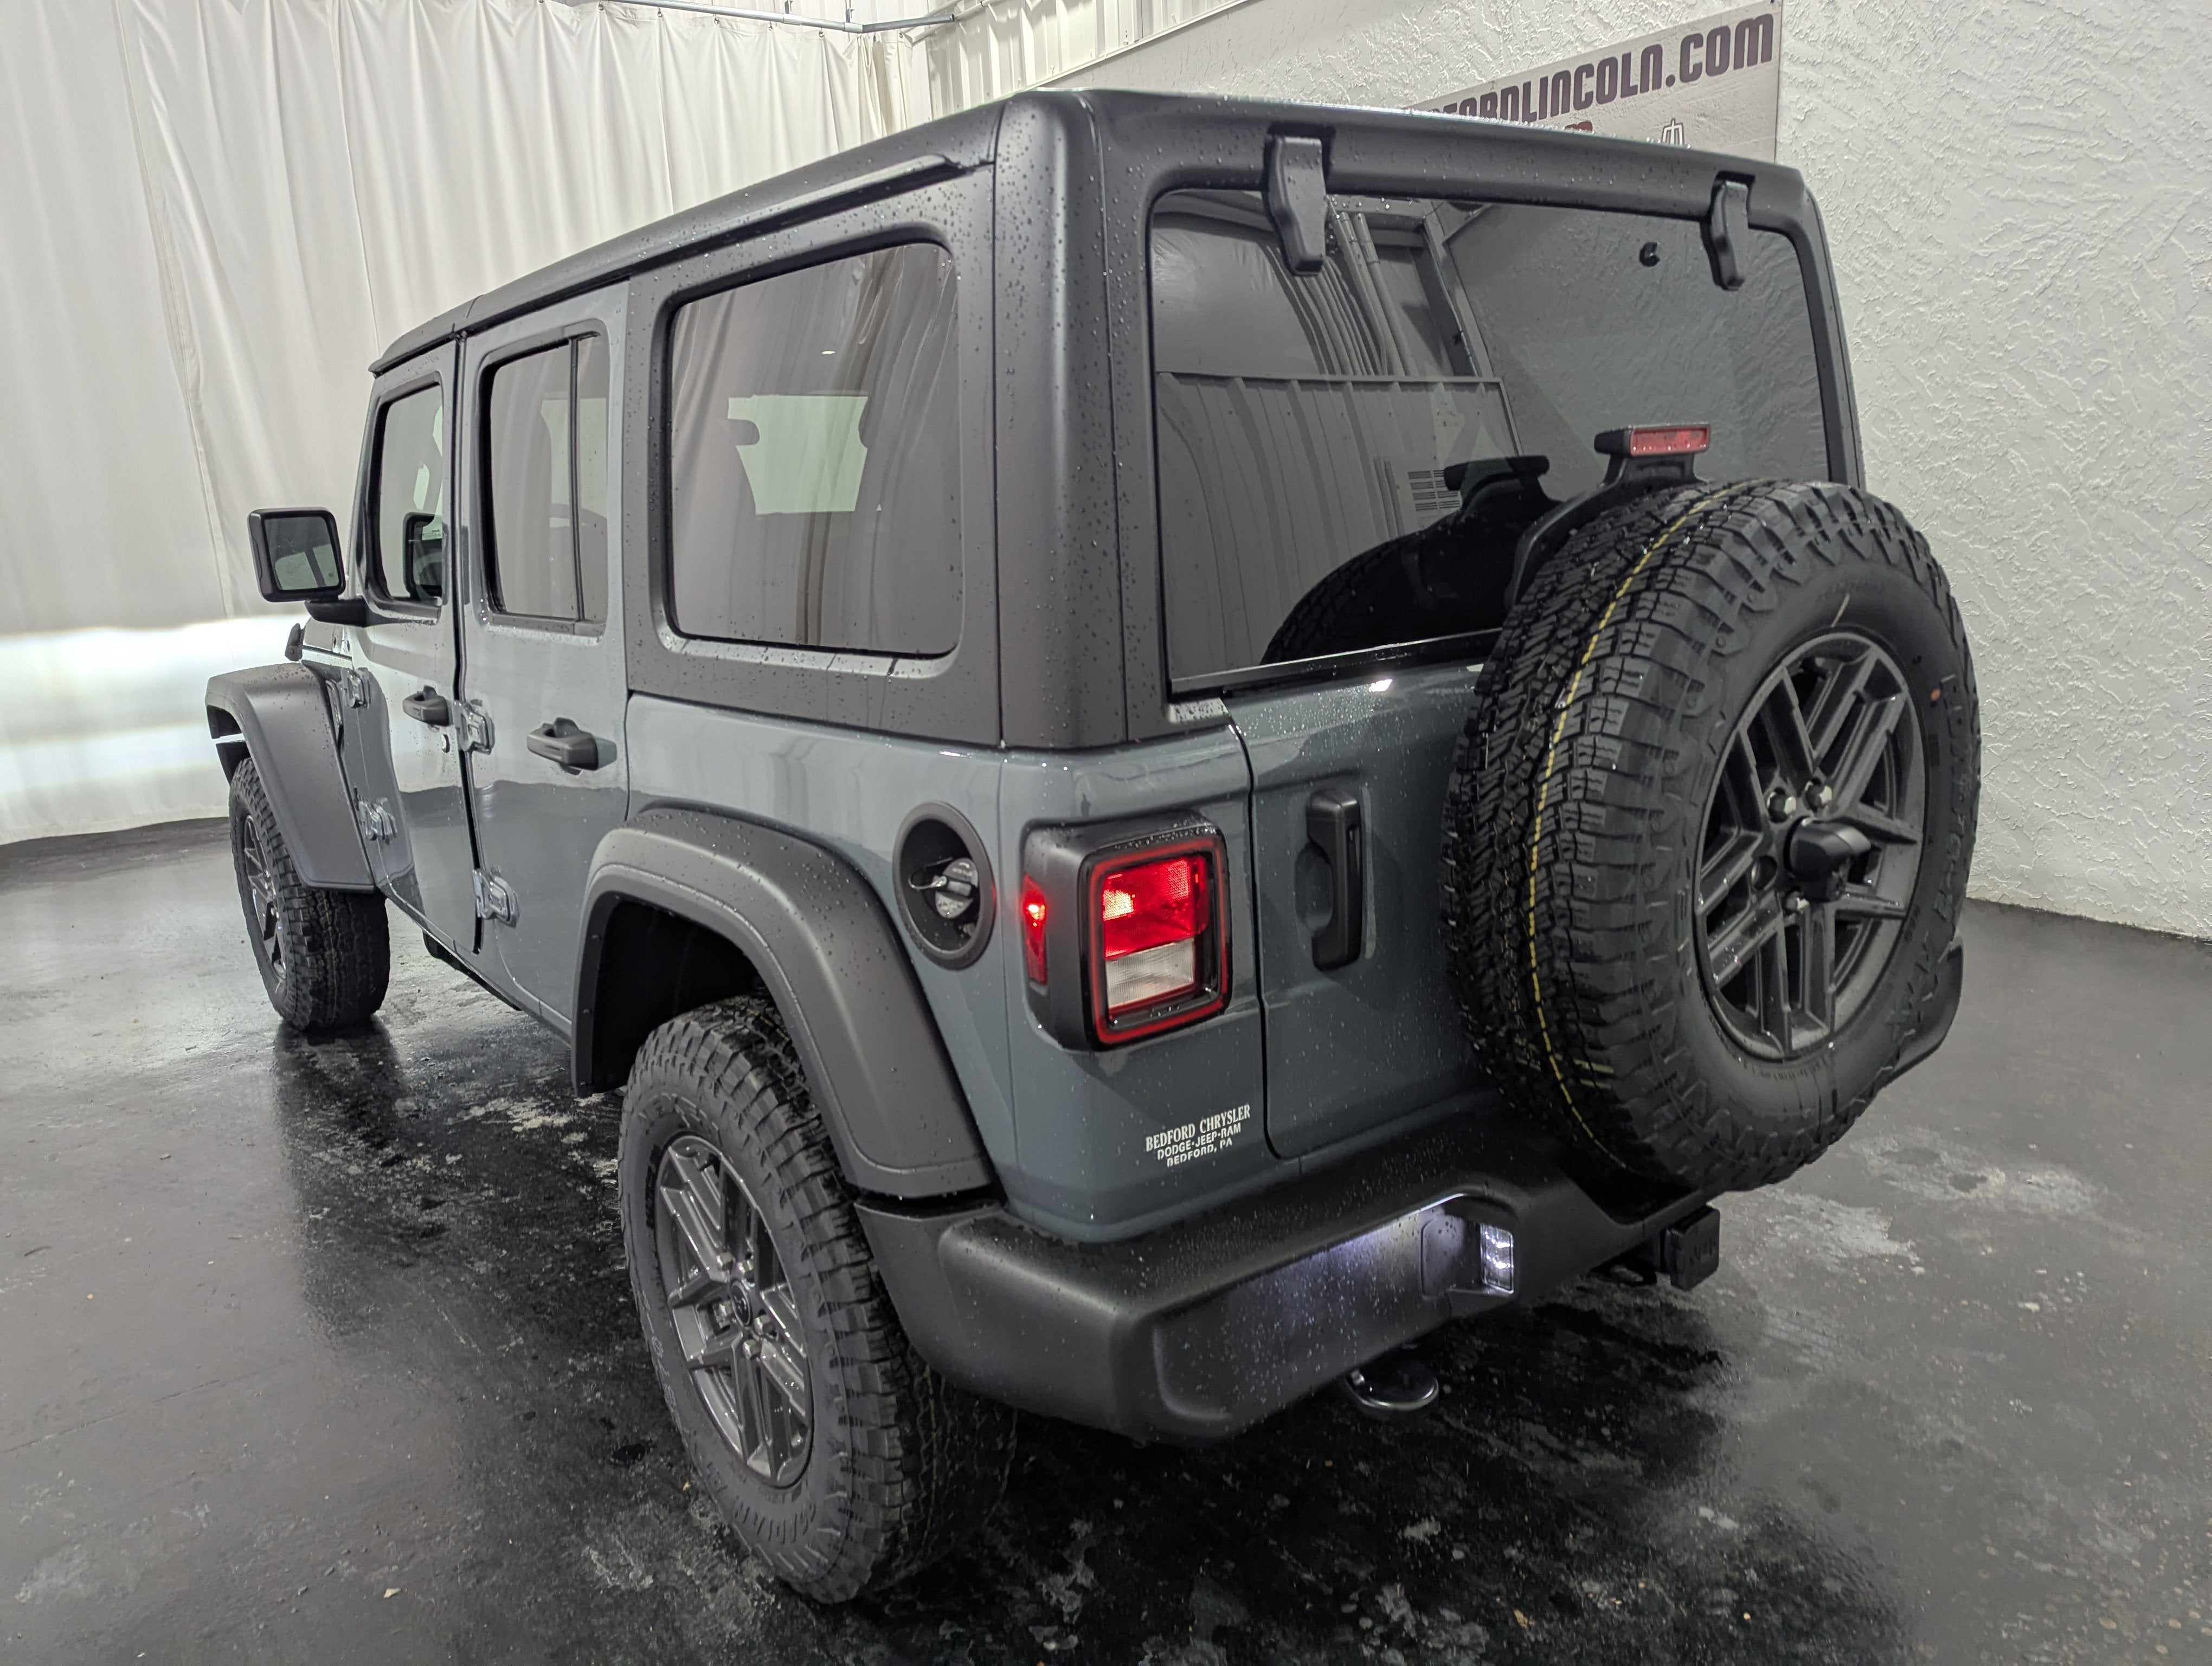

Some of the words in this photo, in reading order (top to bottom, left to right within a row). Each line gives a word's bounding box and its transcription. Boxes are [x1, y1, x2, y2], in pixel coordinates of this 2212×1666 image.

[1145, 1123, 1195, 1152] BEDFORD
[1199, 1104, 1251, 1133] CHRYSLER
[1167, 1144, 1218, 1167] BEDFORD,
[1220, 1137, 1233, 1150] PA
